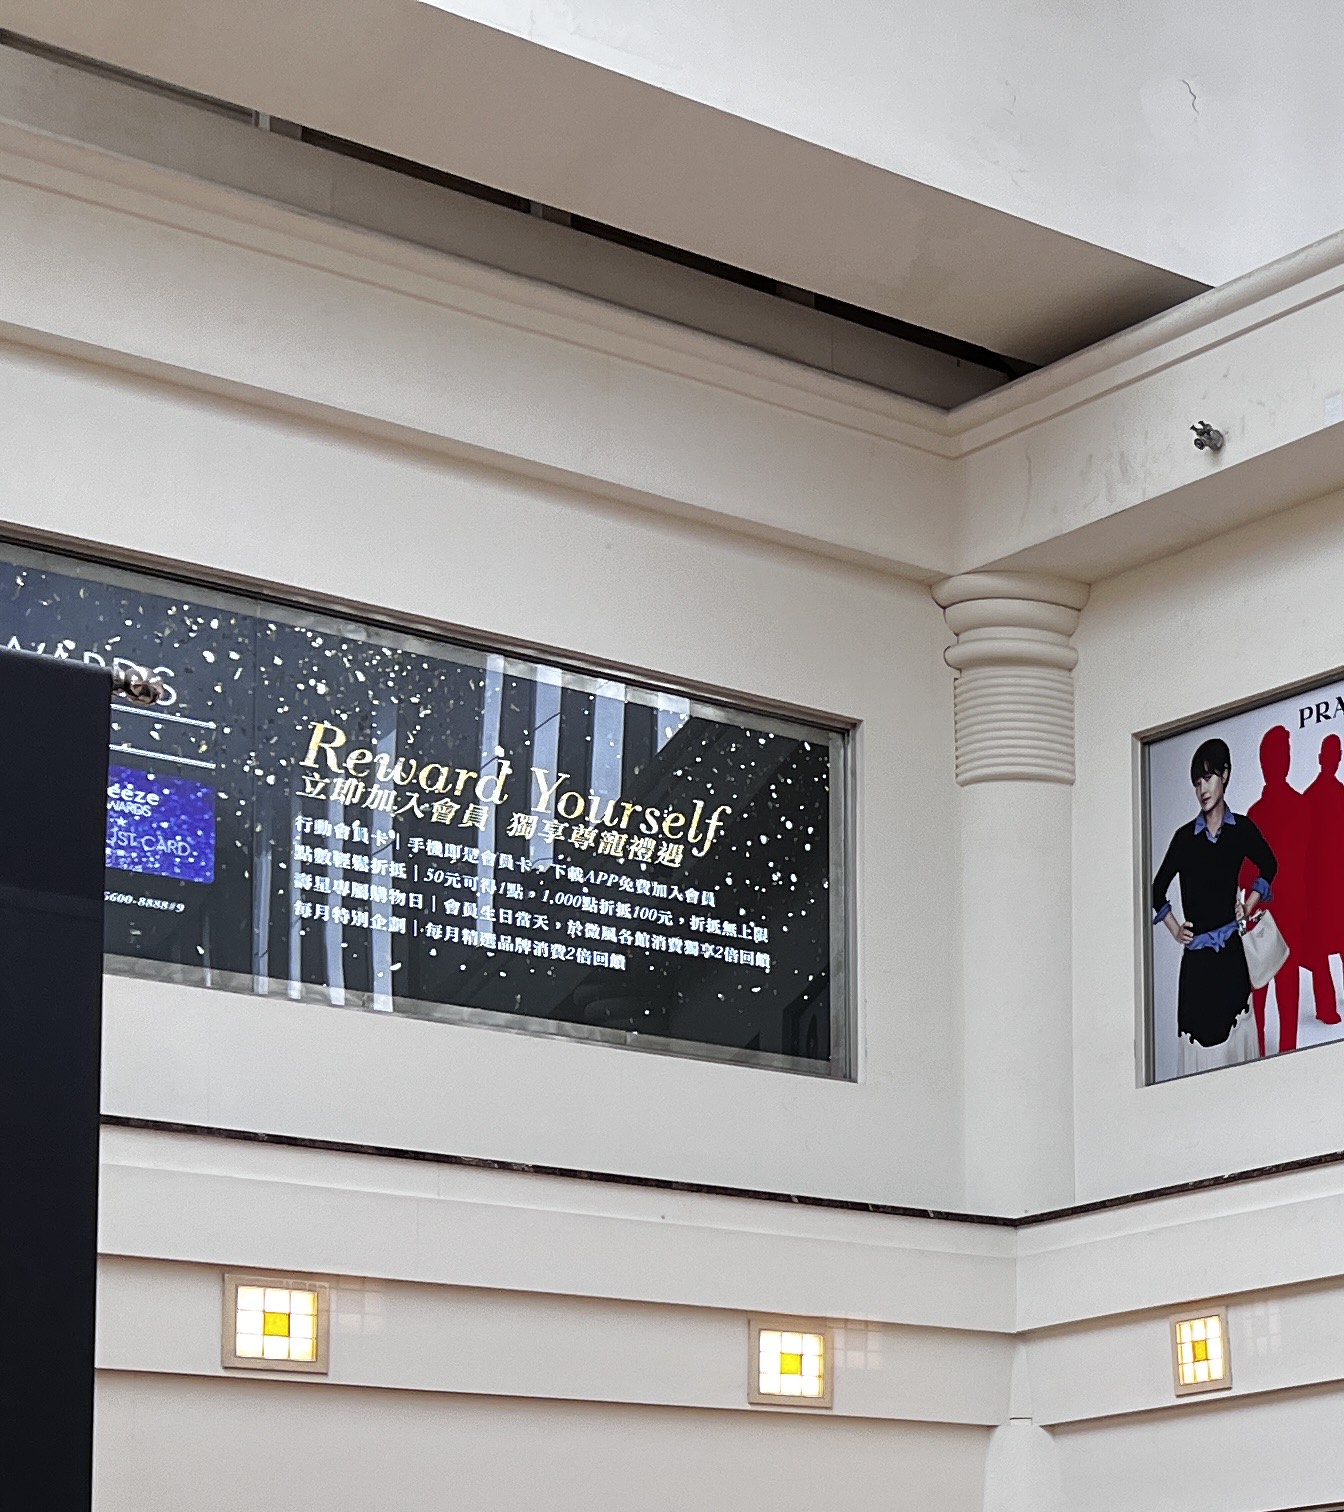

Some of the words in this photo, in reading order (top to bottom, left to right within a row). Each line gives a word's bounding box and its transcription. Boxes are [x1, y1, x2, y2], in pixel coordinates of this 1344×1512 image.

[296, 772, 489, 831] 立即加入會員
[506, 812, 685, 868] 獨享尊寵禮遇
[299, 721, 511, 804] Reward
[531, 767, 732, 857] Yourself
[141, 835, 191, 856] CARD
